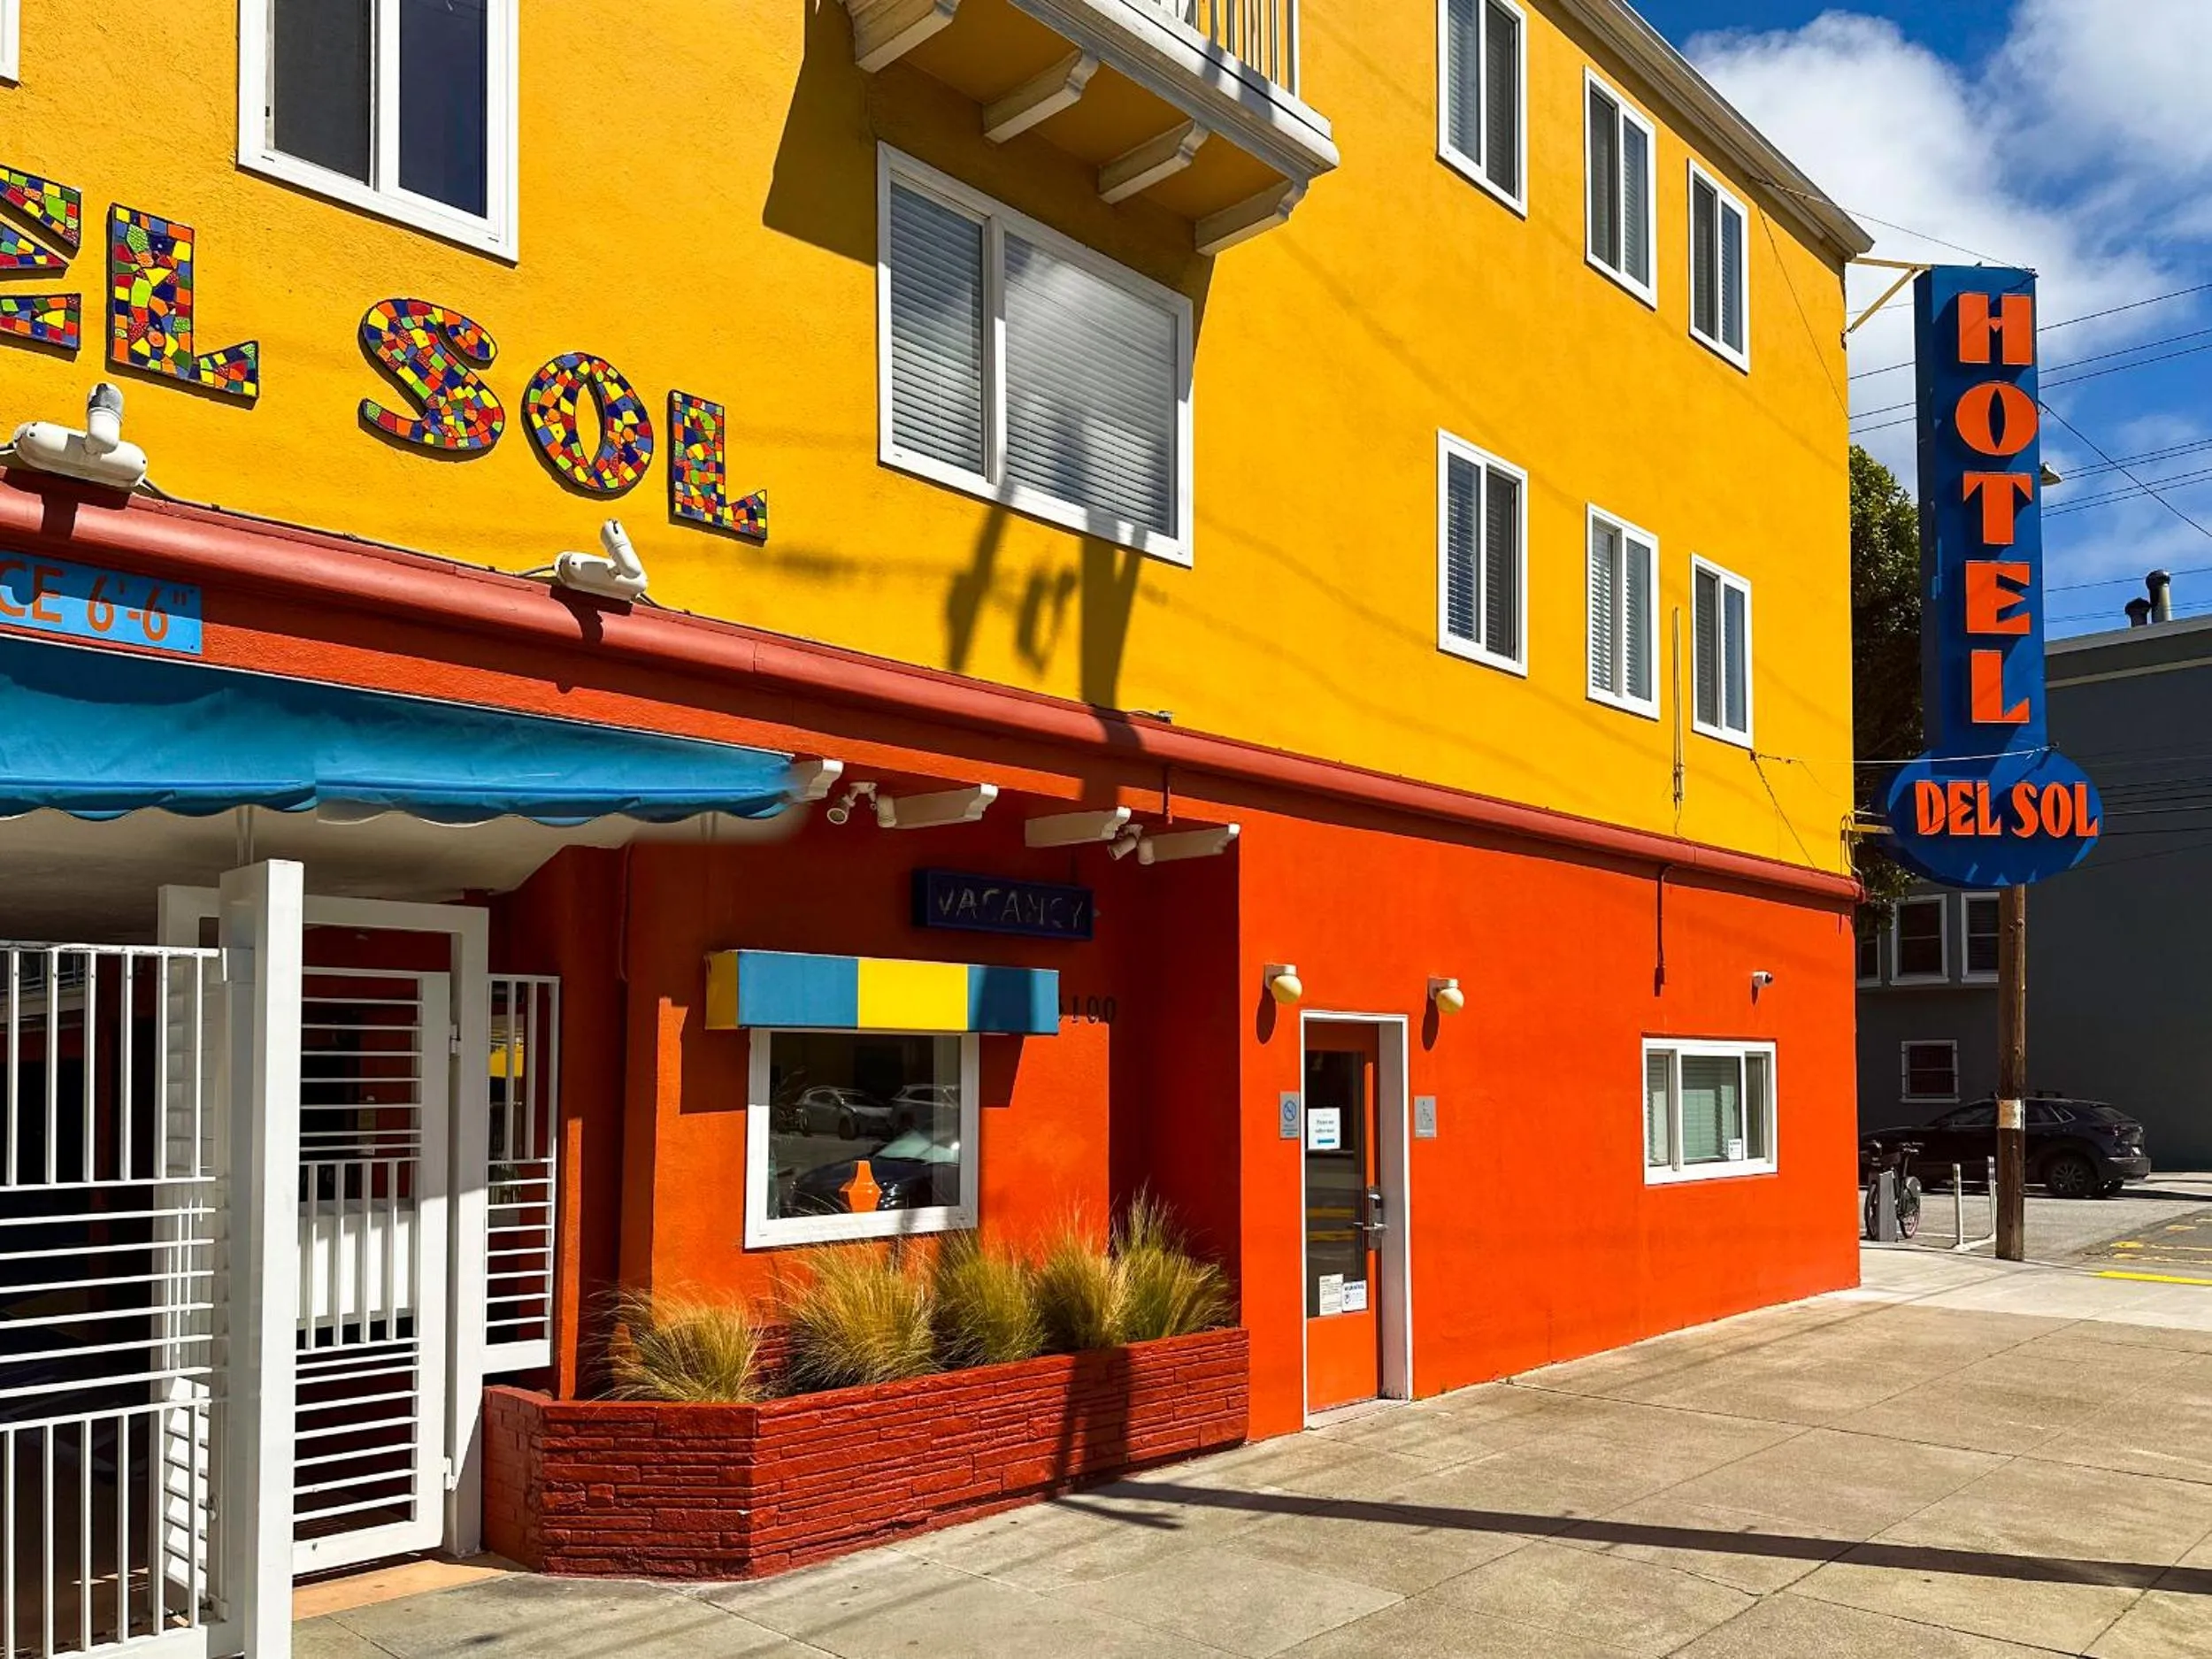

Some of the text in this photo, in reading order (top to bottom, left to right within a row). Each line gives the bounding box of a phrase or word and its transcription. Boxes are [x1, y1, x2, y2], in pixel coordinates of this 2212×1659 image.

[357, 297, 768, 543] SOL
[1955, 292, 2038, 725] HOTEL
[0, 558, 64, 623] CE
[1915, 780, 2098, 838] DEL SOL
[938, 887, 1084, 929] VACANCY
[1058, 995, 1116, 1024] 100
